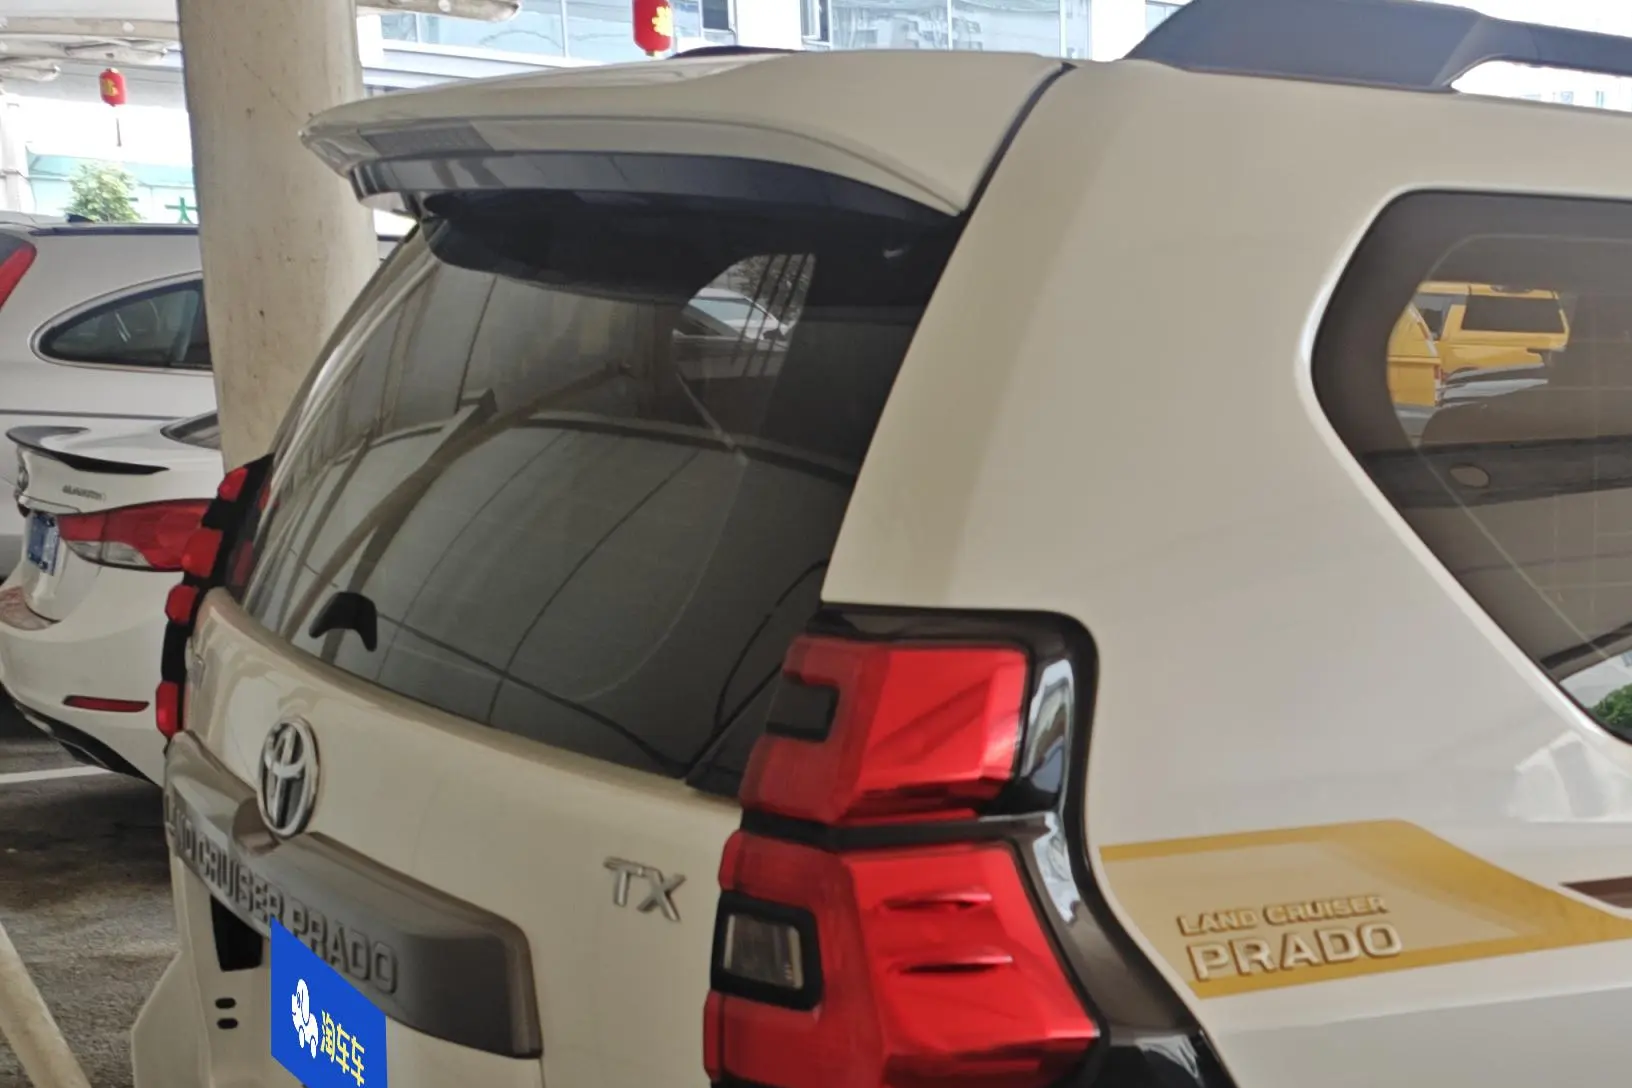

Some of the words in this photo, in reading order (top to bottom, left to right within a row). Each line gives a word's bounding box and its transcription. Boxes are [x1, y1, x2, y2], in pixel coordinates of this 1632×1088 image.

[603, 856, 687, 922] TX
[1177, 909, 1258, 937] LAND
[1263, 896, 1389, 926] CRUISER
[290, 897, 398, 996] PRADO
[1187, 922, 1402, 982] PRADO
